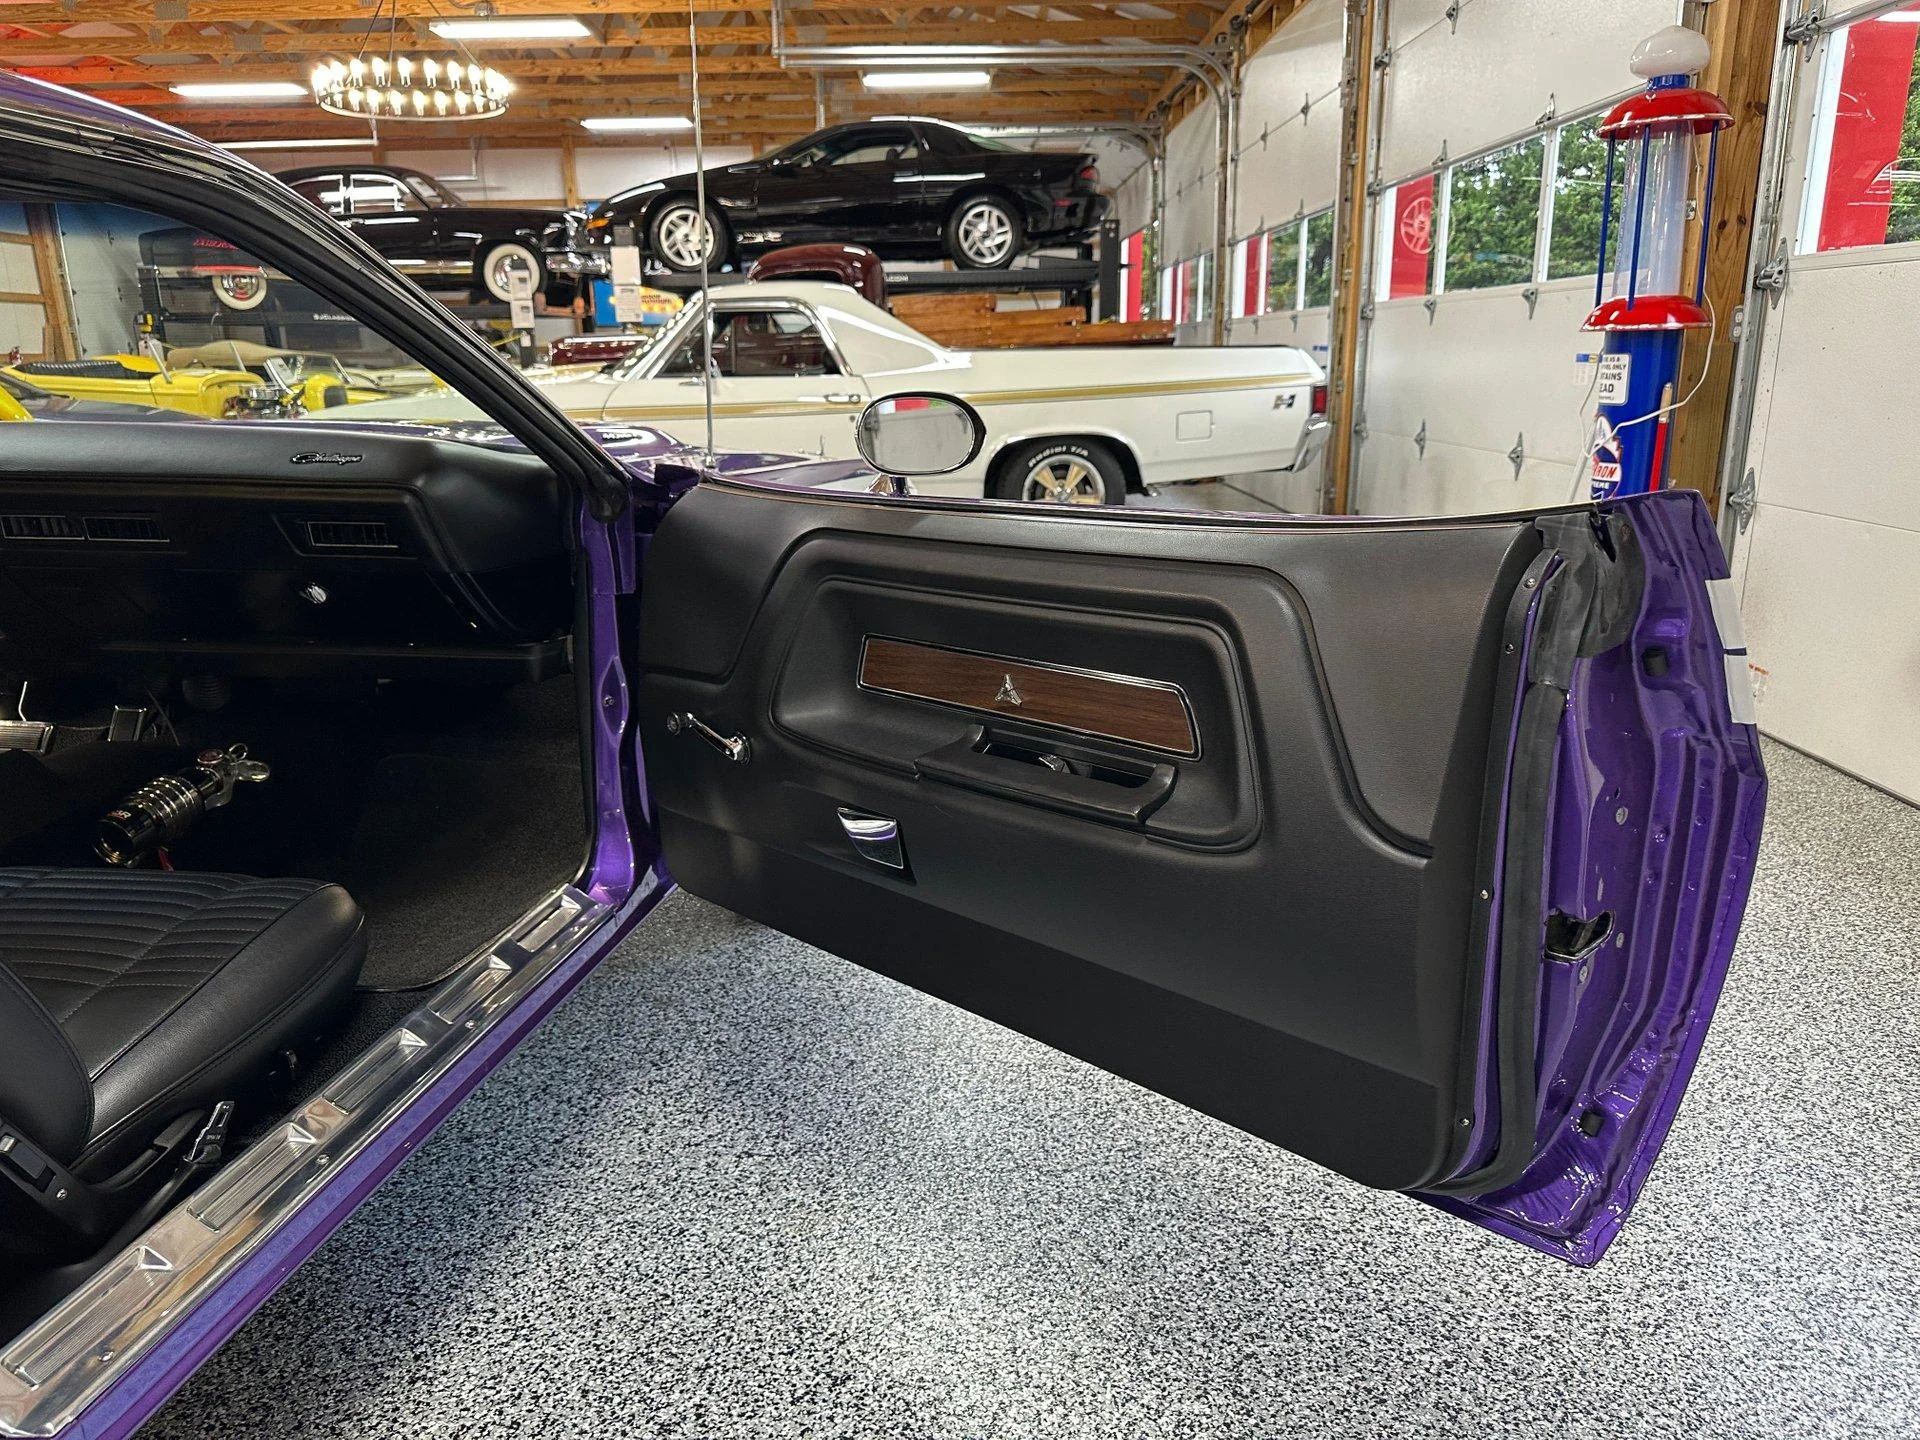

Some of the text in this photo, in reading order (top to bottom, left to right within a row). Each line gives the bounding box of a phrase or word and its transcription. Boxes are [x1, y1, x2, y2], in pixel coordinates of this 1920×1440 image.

[1600, 372, 1622, 381] TAINS
[1028, 445, 1089, 468] Radial T/A
